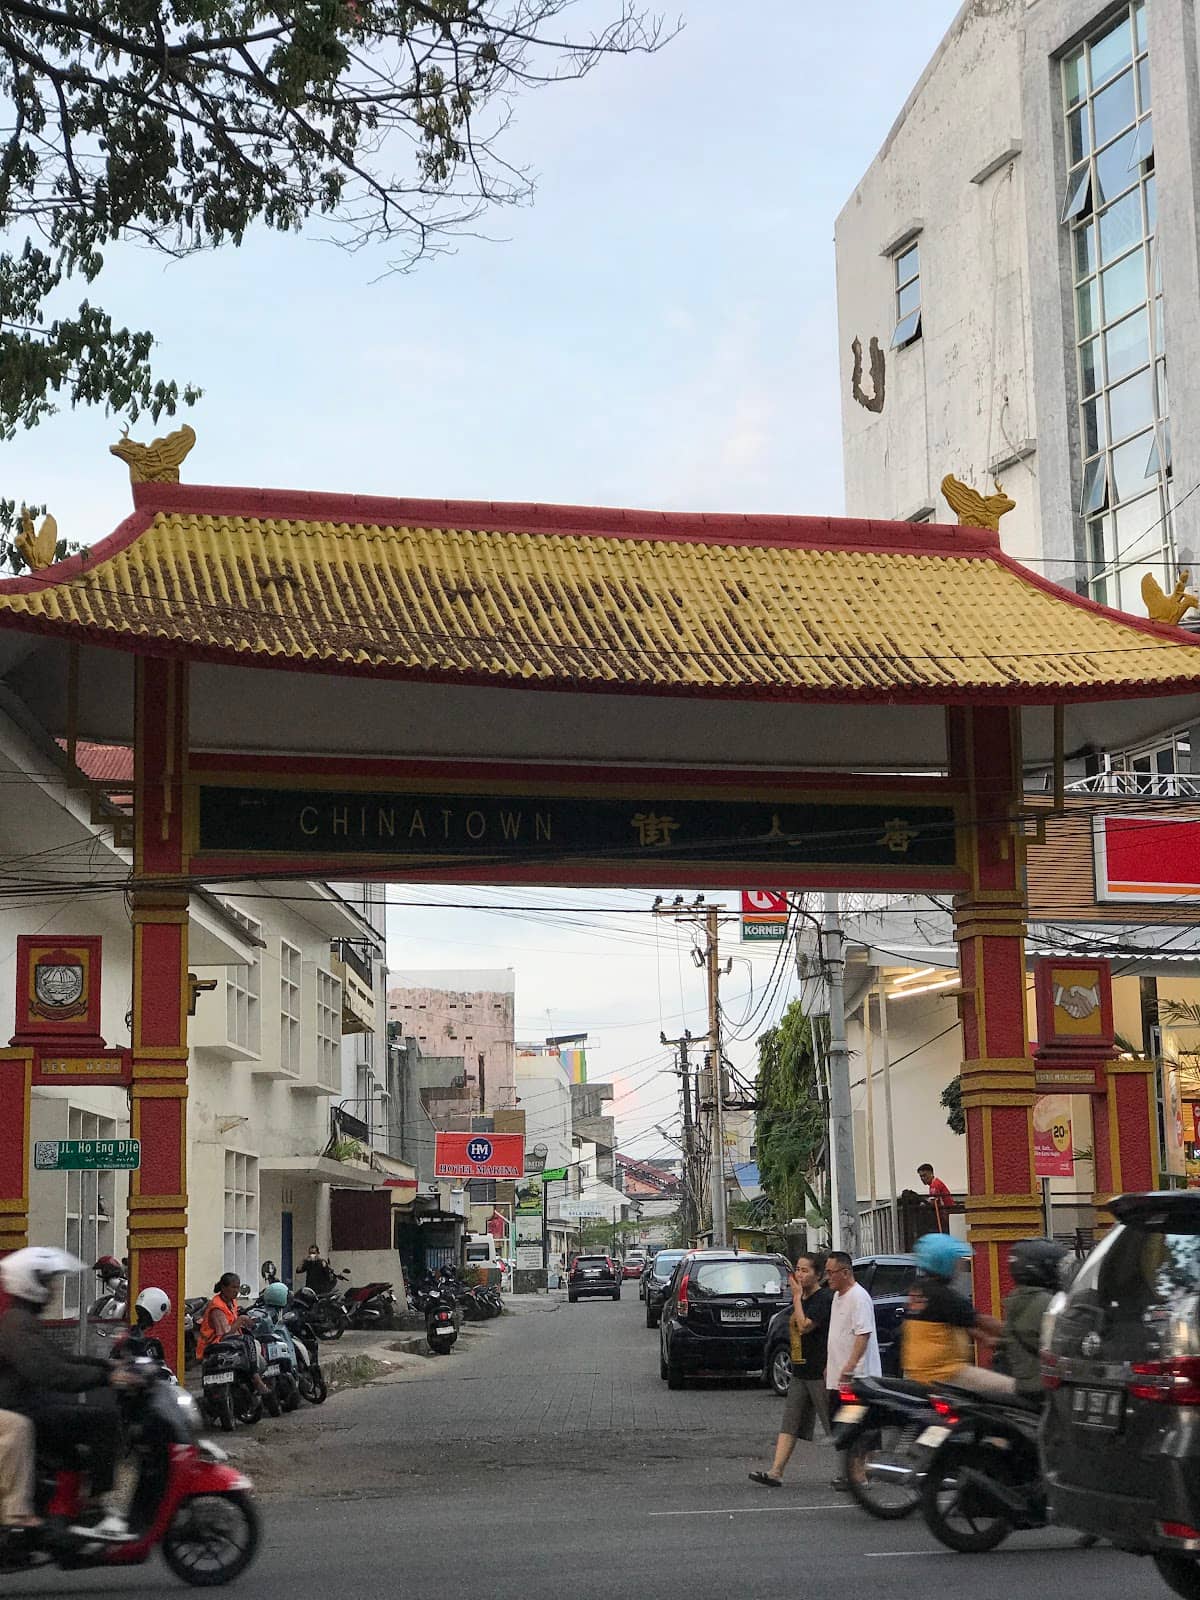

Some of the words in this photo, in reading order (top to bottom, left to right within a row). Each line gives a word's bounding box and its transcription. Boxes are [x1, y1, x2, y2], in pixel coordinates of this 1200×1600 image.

[300, 806, 551, 841] CHINATOWN
[744, 924, 785, 935] KÖRNER
[1054, 1126, 1065, 1138] 20
[60, 1142, 73, 1153] JL.
[78, 1142, 91, 1153] Ho
[95, 1142, 114, 1155] Eng
[118, 1141, 139, 1155] Djie
[471, 1143, 488, 1155] HM
[439, 1163, 474, 1175] HOTEL
[476, 1164, 519, 1176] MARINA
